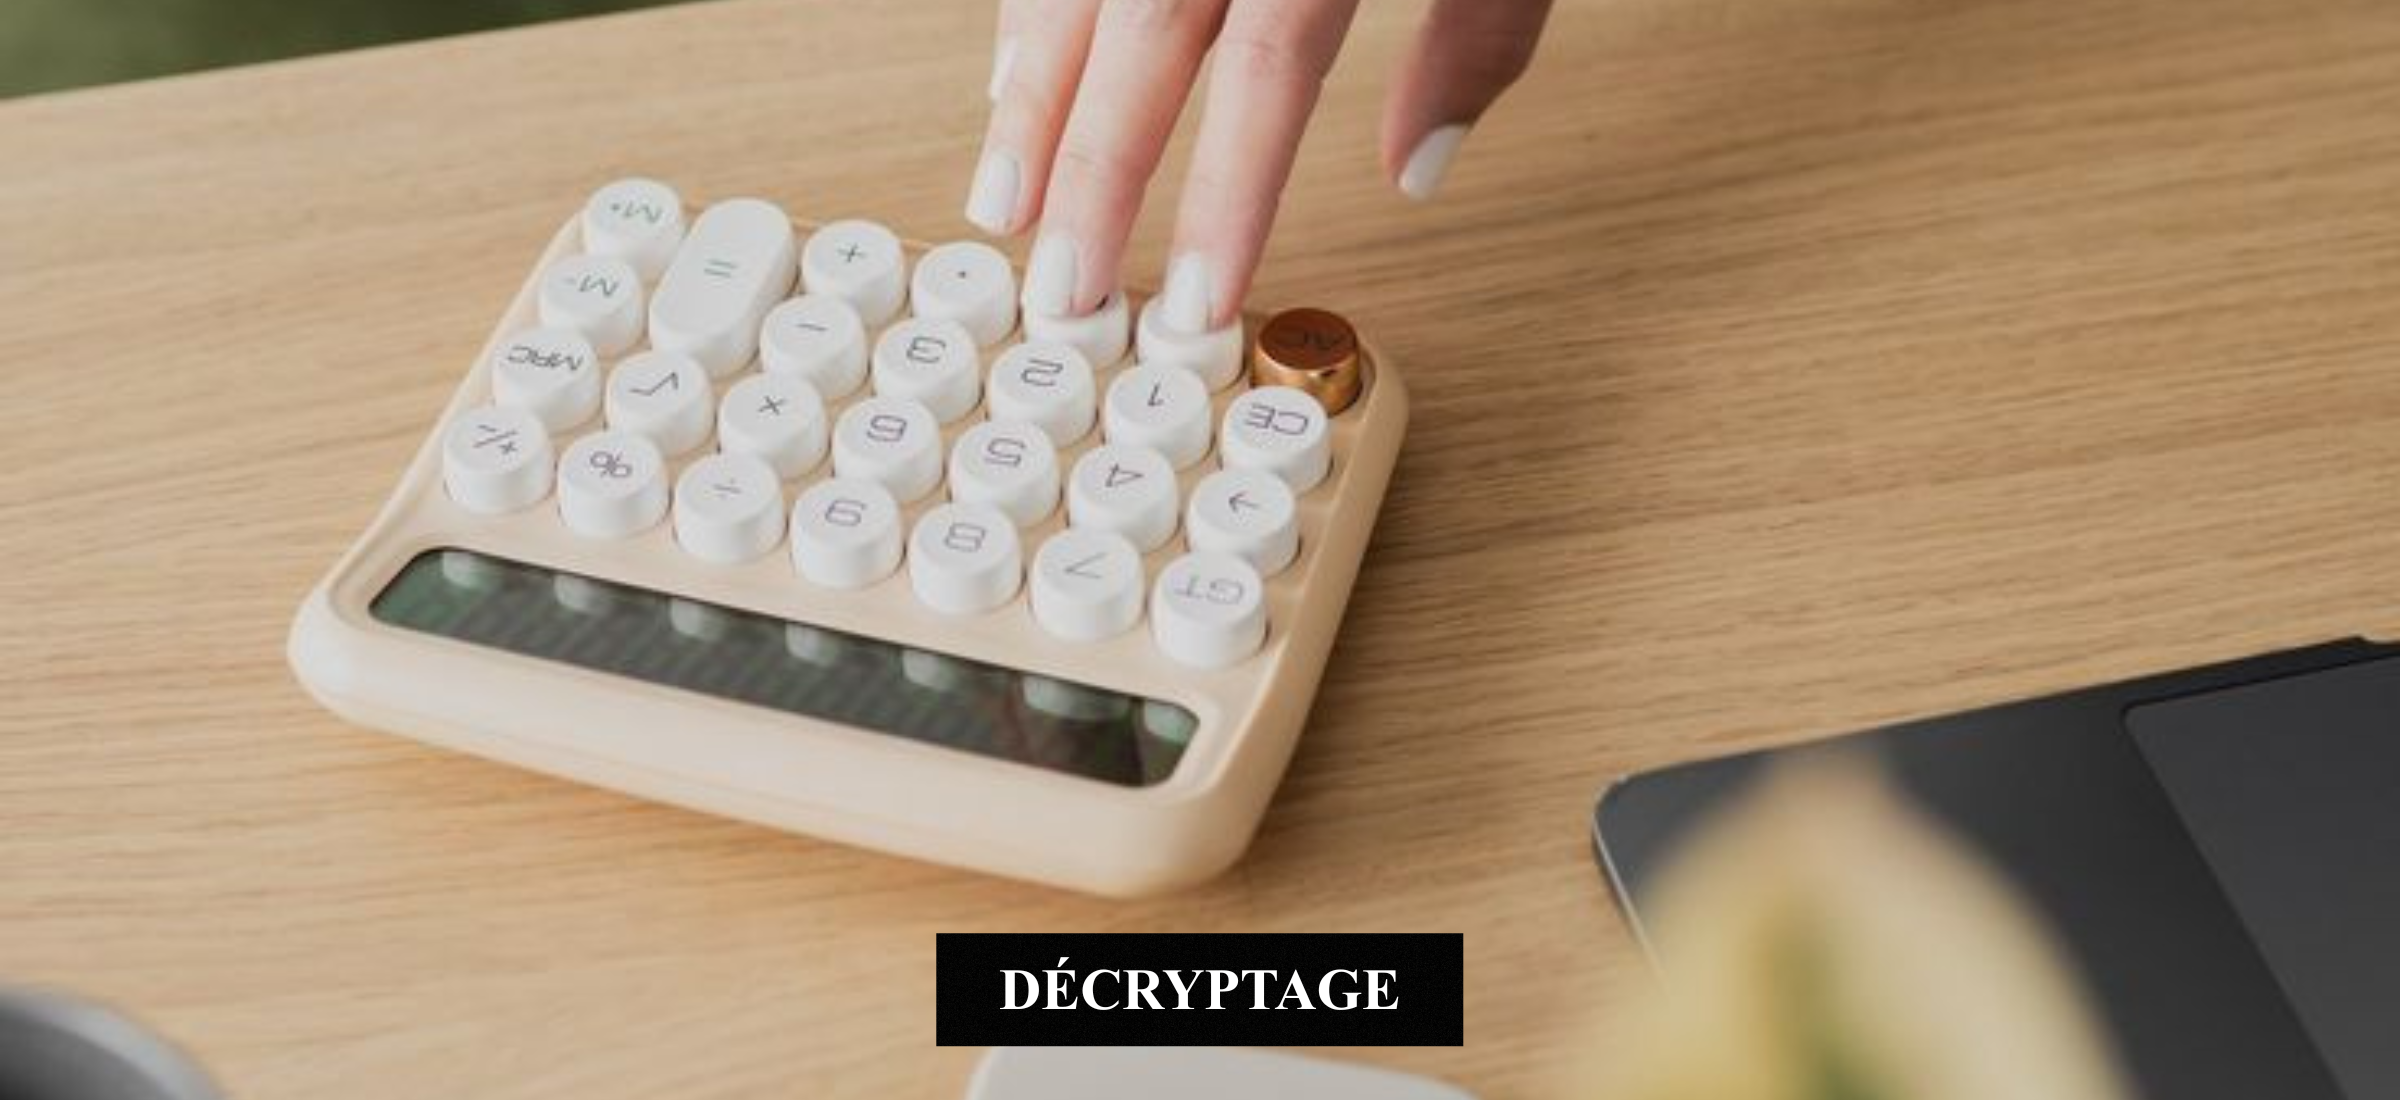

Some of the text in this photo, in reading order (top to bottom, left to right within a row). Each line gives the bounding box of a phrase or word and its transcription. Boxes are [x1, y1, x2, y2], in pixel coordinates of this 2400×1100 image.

[906, 337, 946, 363] 3
[1021, 359, 1063, 386] 2
[1148, 385, 1162, 406] 1
[866, 415, 907, 441] 6
[1246, 404, 1308, 435] CE
[590, 452, 632, 477] %
[985, 438, 1026, 467] 5
[1106, 464, 1143, 487] 4
[825, 500, 866, 526] 9
[944, 523, 986, 552] 8
[1064, 553, 1105, 579] 7
[1176, 576, 1243, 603] GT
